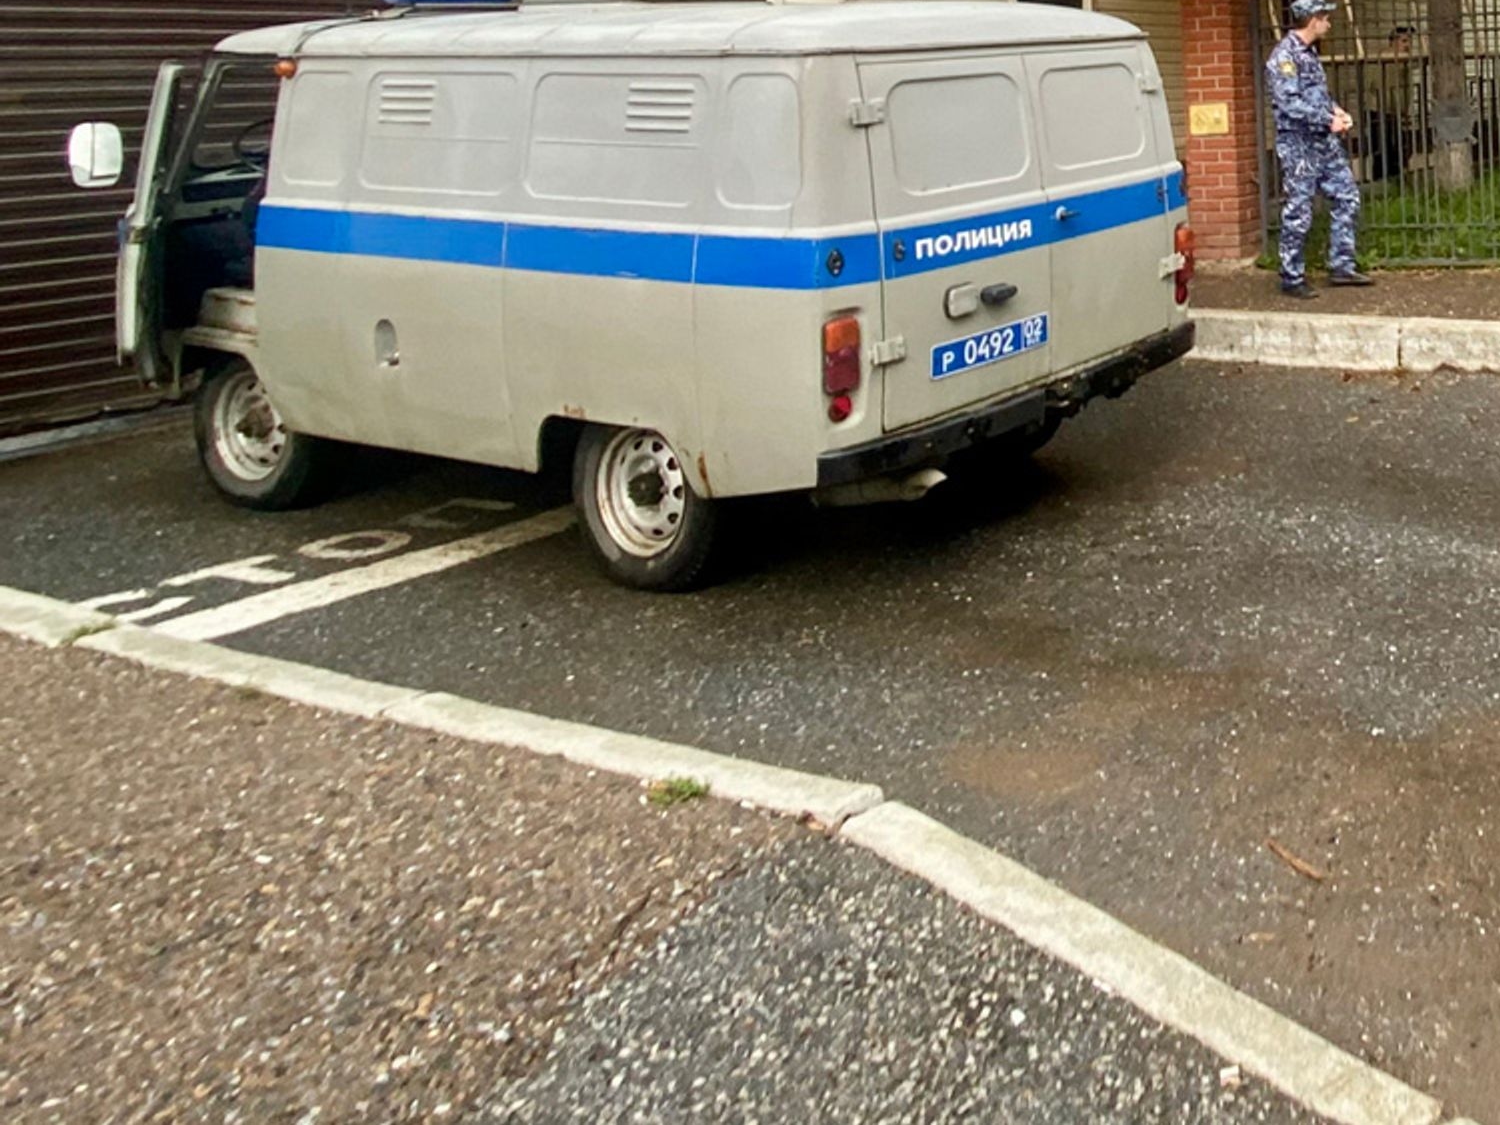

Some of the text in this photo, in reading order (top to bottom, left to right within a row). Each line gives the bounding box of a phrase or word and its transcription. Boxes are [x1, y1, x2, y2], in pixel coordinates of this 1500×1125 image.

[915, 218, 1032, 260] ПОЛИЦИЯ
[942, 351, 955, 372] Р
[964, 327, 1014, 364] 0492
[1024, 318, 1043, 338] 02
